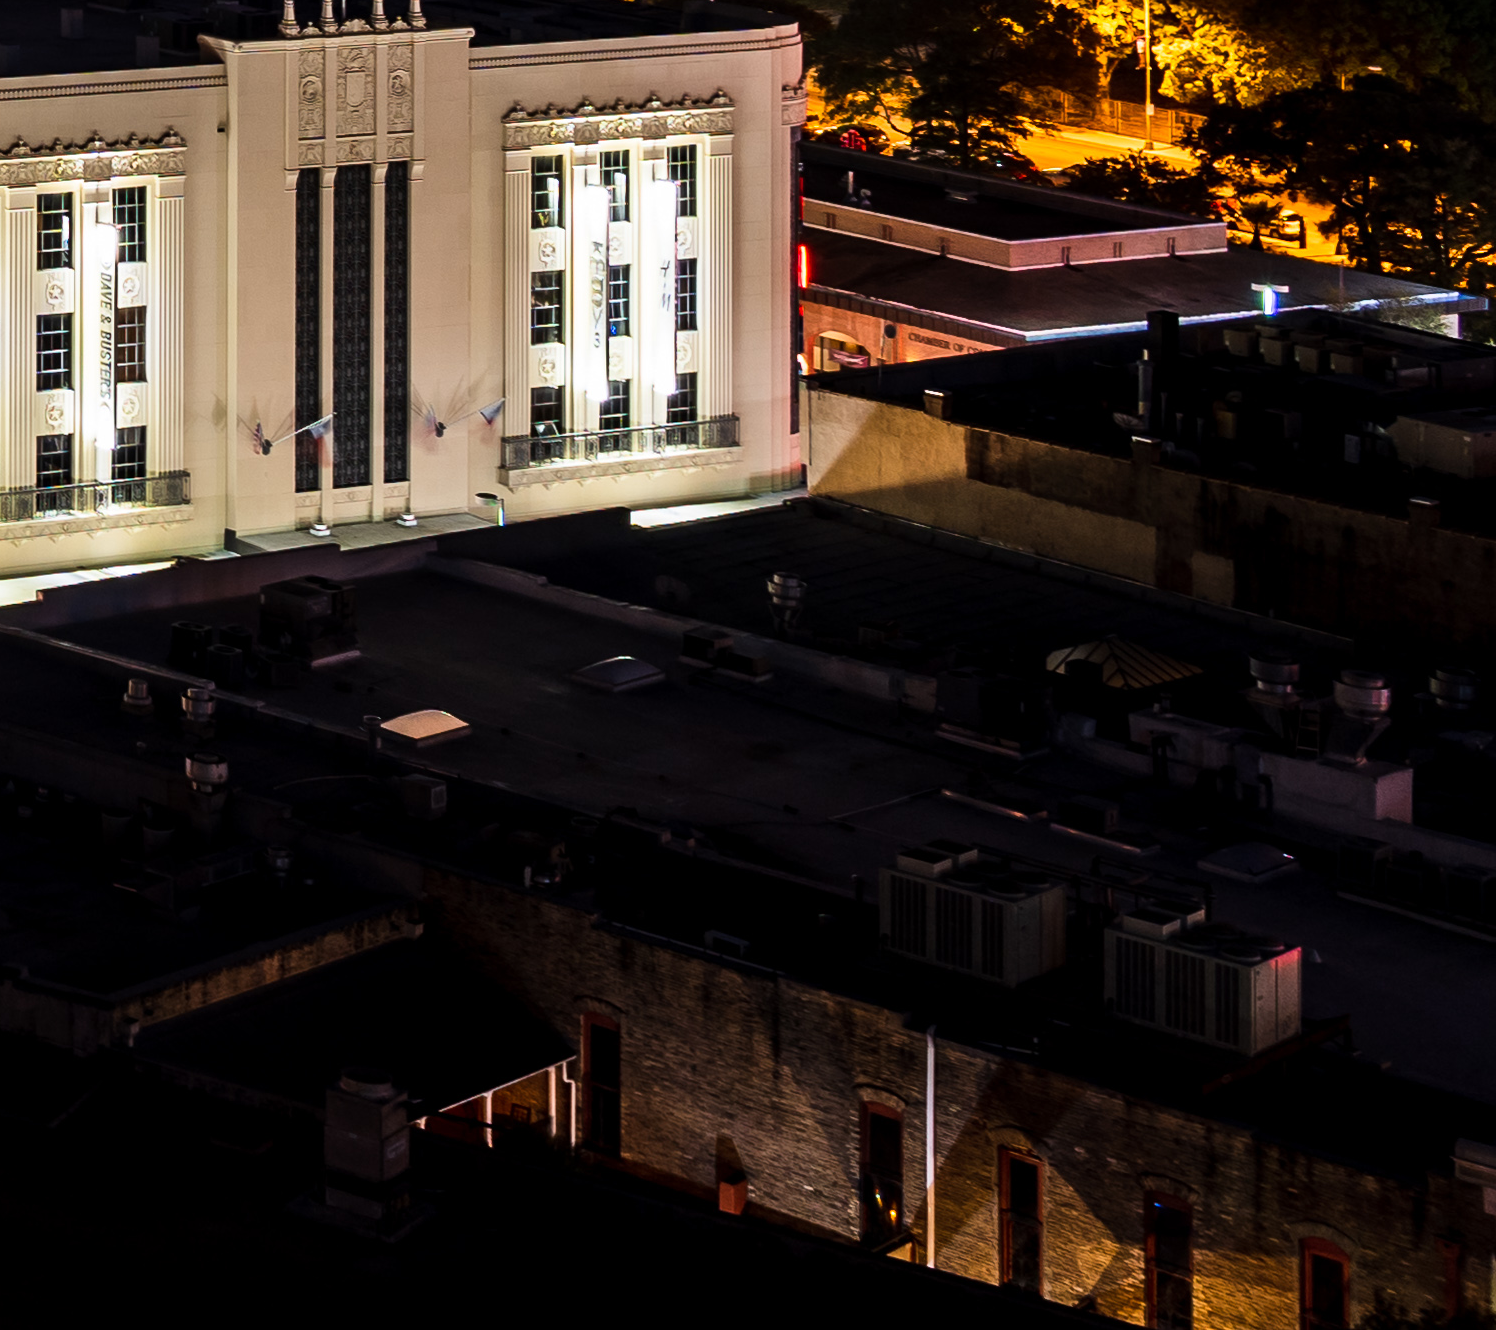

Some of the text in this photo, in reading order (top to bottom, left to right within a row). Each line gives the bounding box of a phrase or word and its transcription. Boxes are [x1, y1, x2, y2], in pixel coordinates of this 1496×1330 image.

[100, 272, 112, 311] DAVE
[100, 314, 112, 324] &
[908, 332, 951, 350] CHAMBER
[953, 343, 964, 353] OF
